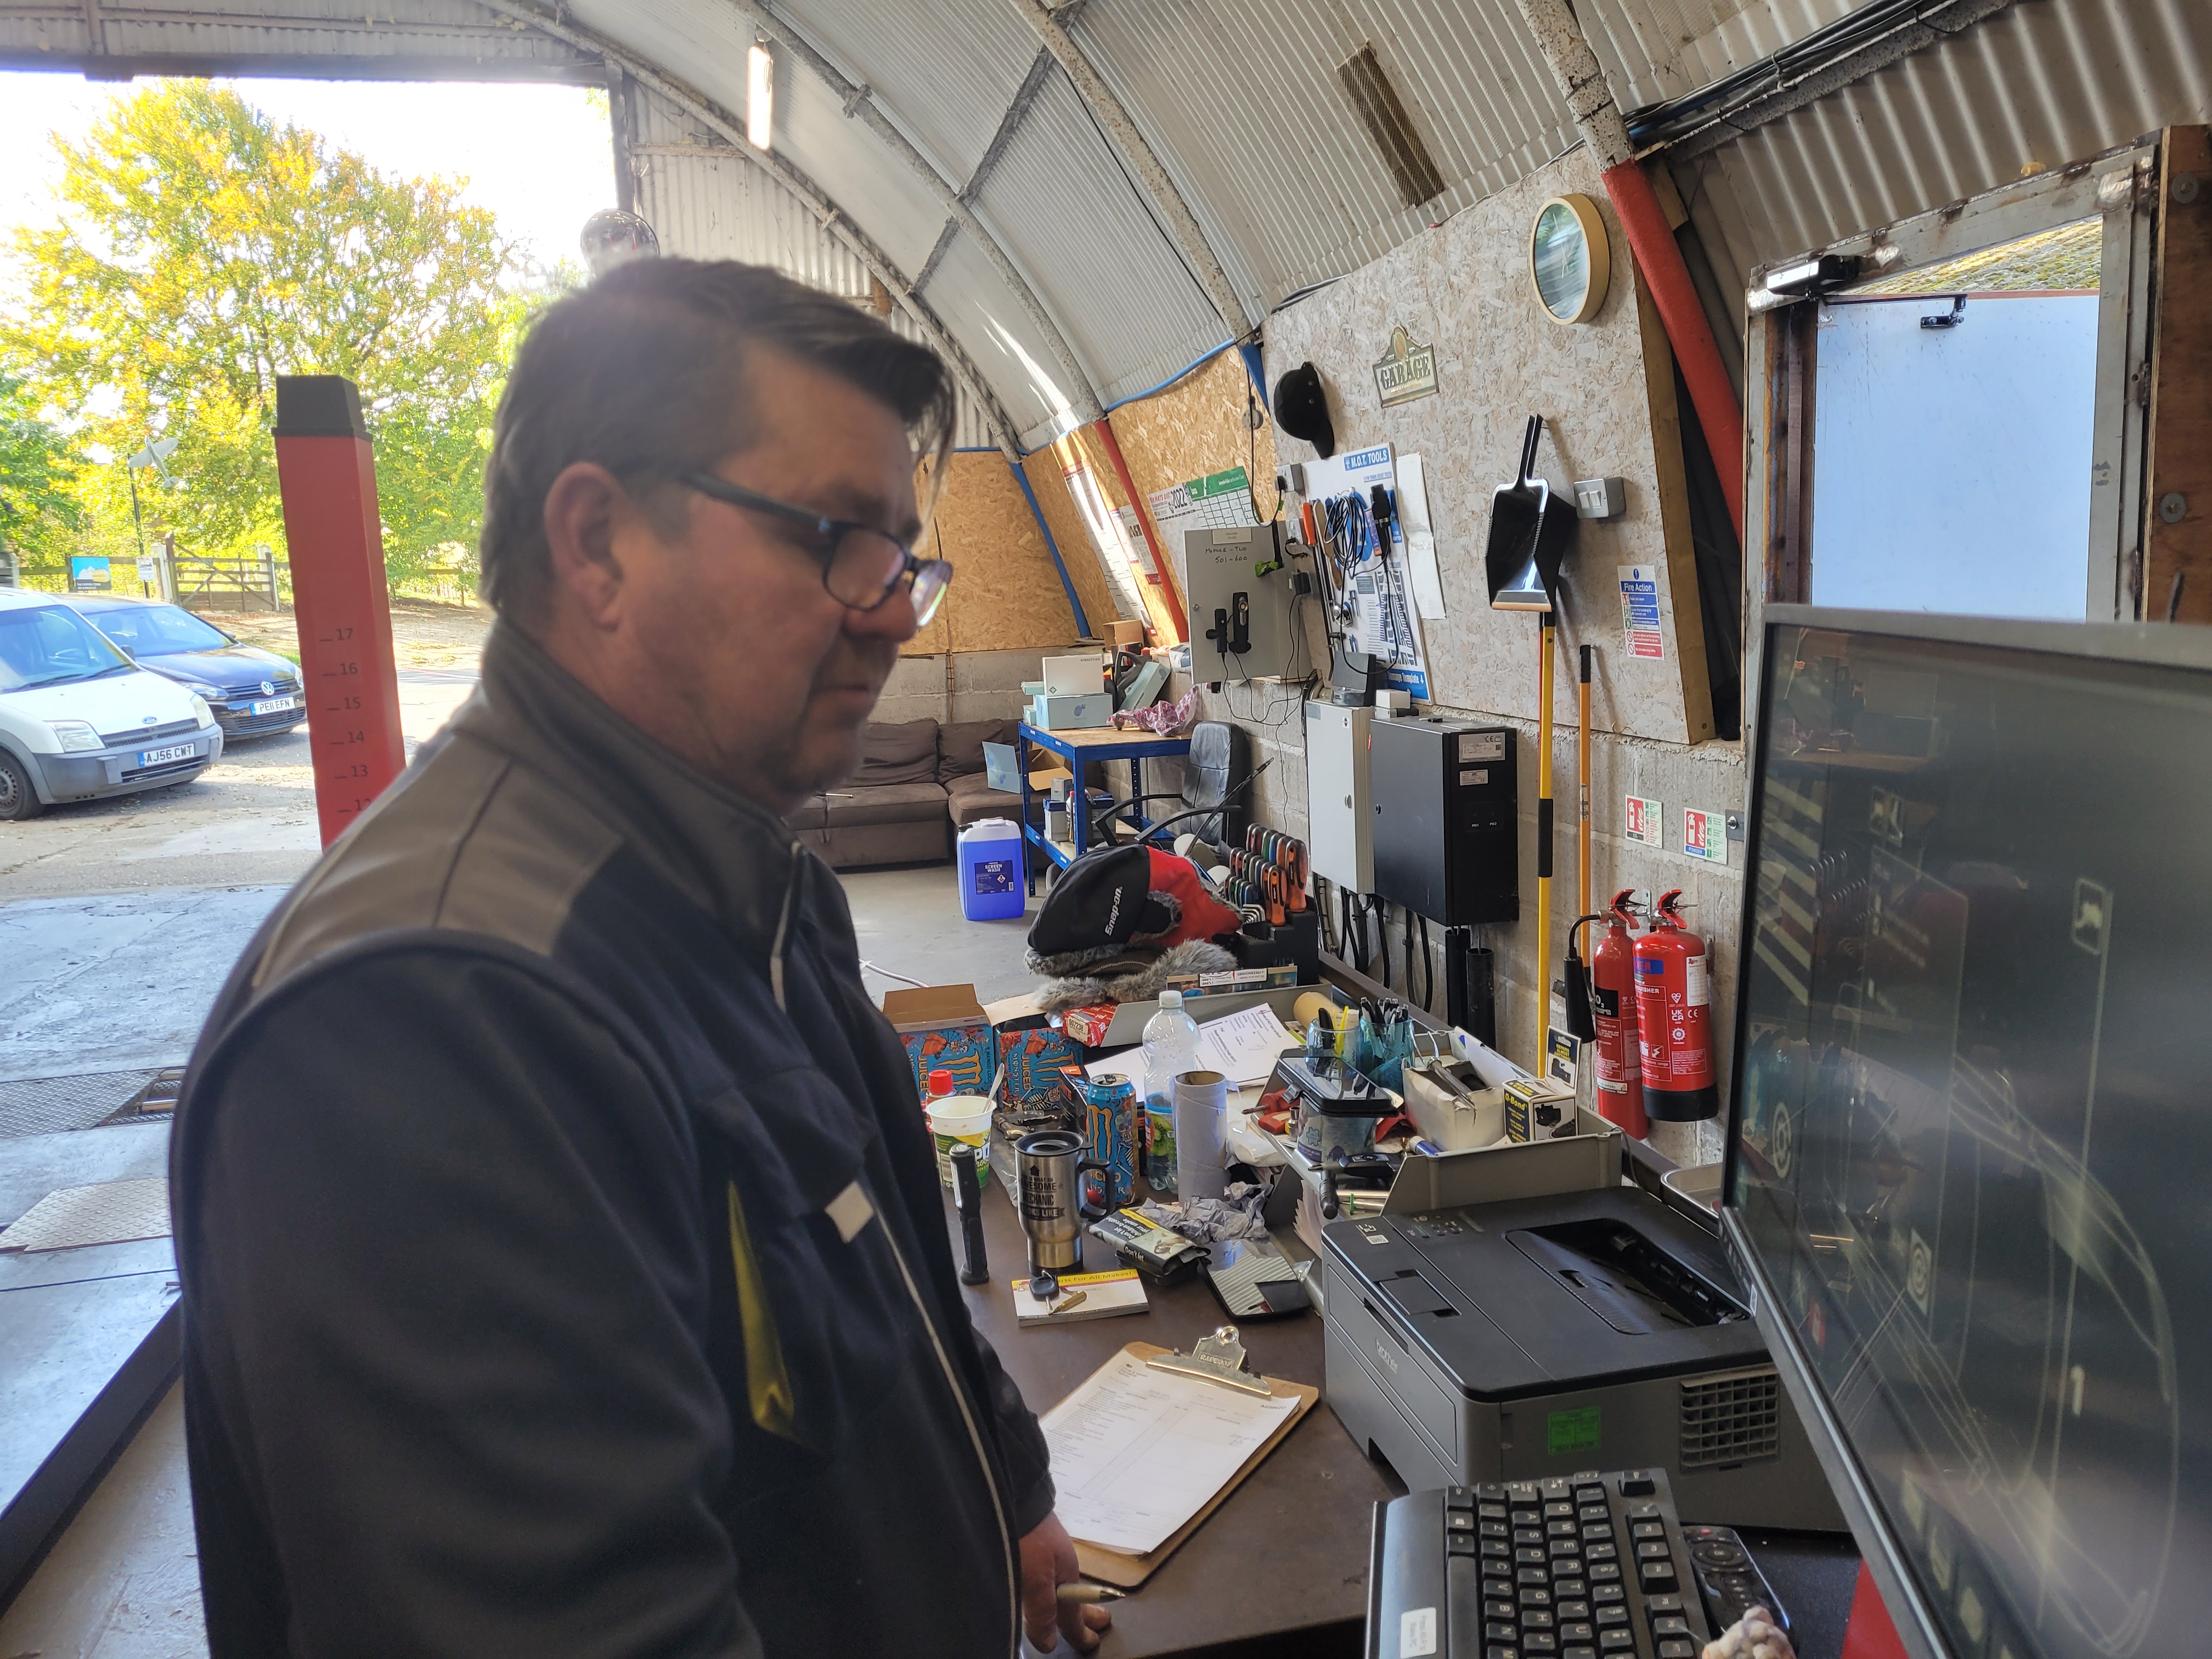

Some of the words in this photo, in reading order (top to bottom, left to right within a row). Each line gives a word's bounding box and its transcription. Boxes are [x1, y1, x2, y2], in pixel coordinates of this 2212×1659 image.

[1380, 354, 1430, 390] GARAGE
[1351, 454, 1367, 468] M.O.T.
[1368, 450, 1387, 464] TOOLS
[1171, 488, 1188, 509] 2022
[1624, 583, 1634, 591] Fire
[1635, 583, 1652, 591] Action
[336, 628, 353, 641] 17
[341, 663, 357, 675] 16
[276, 698, 290, 709] EFN
[345, 697, 361, 709] 15
[348, 731, 364, 743] 14
[146, 749, 172, 763] AJ56
[174, 745, 192, 758] CWT
[352, 765, 368, 777] 13
[1069, 1019, 1084, 1031] 007238
[1021, 1054, 1031, 1090] JUICED
[1505, 1093, 1525, 1111] Q-Bond
[1042, 1209, 1058, 1217] LIKE
[1125, 1246, 1138, 1259] Don't
[1376, 1338, 1398, 1372] brother
